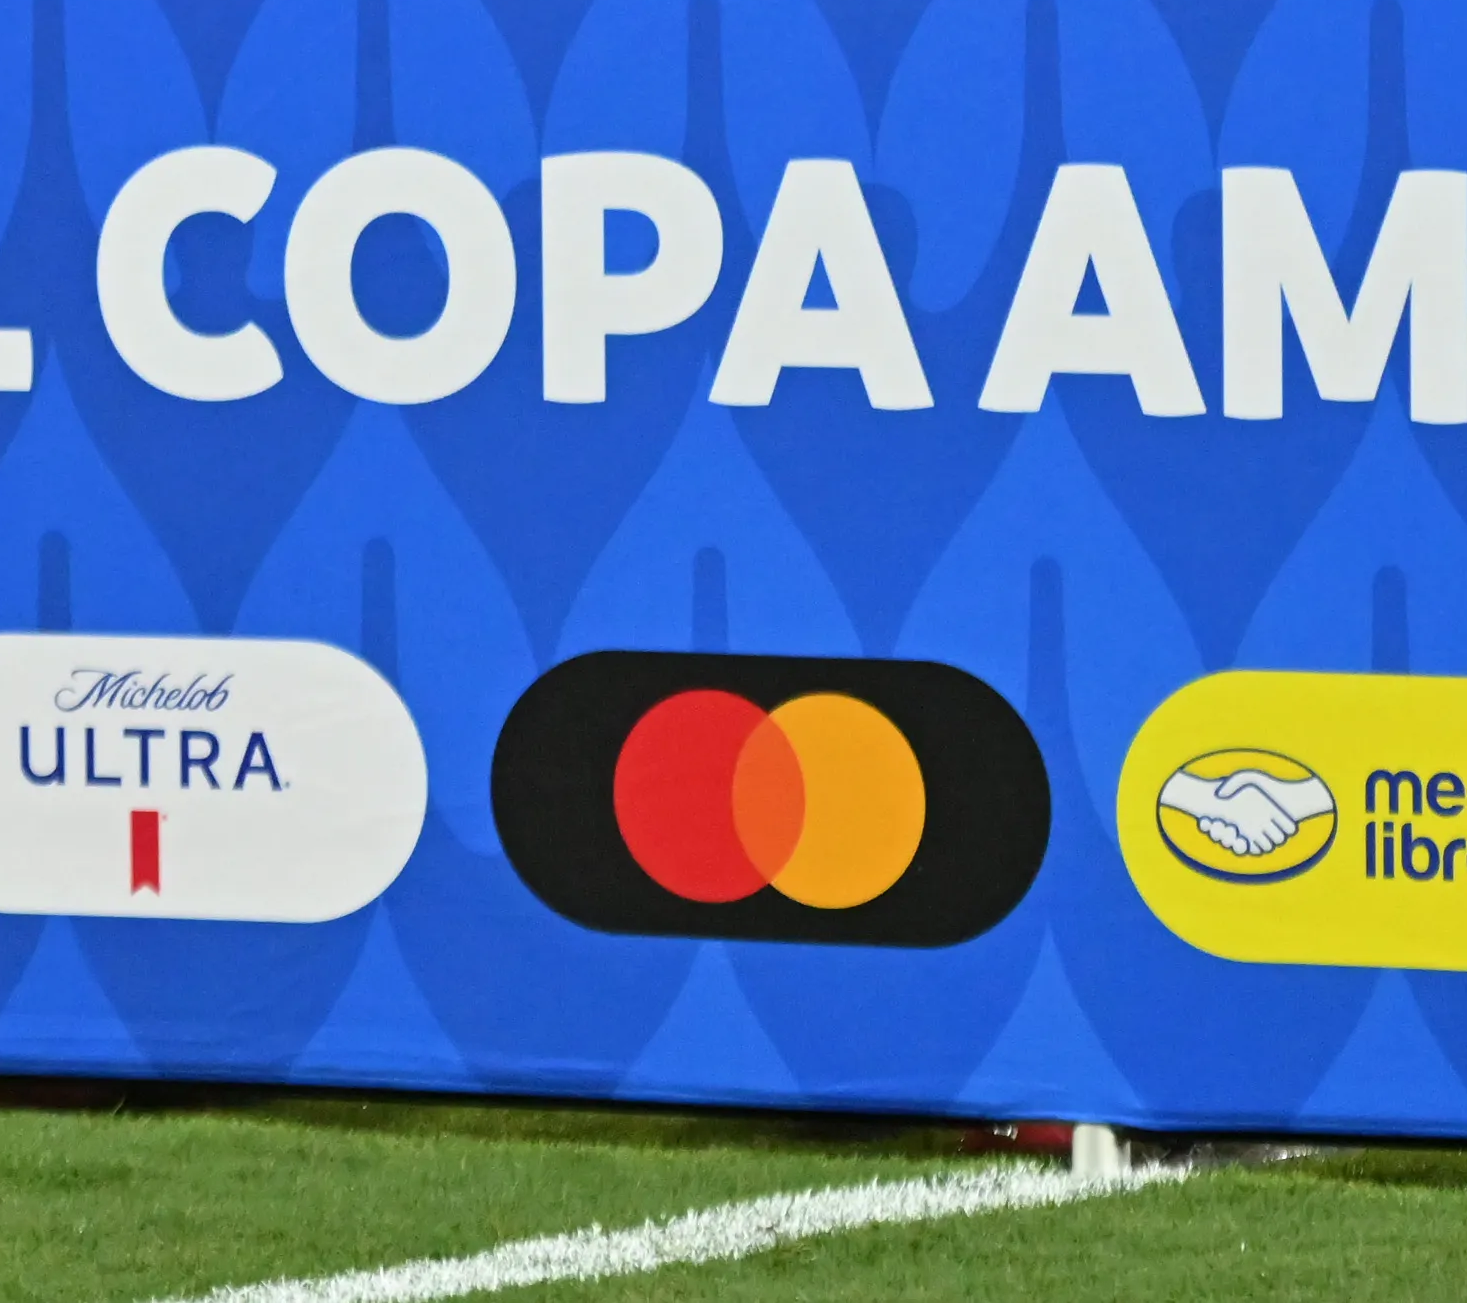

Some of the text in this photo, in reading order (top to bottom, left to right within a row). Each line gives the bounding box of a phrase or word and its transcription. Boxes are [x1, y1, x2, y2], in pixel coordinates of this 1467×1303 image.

[96, 145, 936, 411] COPA
[54, 670, 235, 712] Michelob
[19, 725, 283, 792] ULTRA
